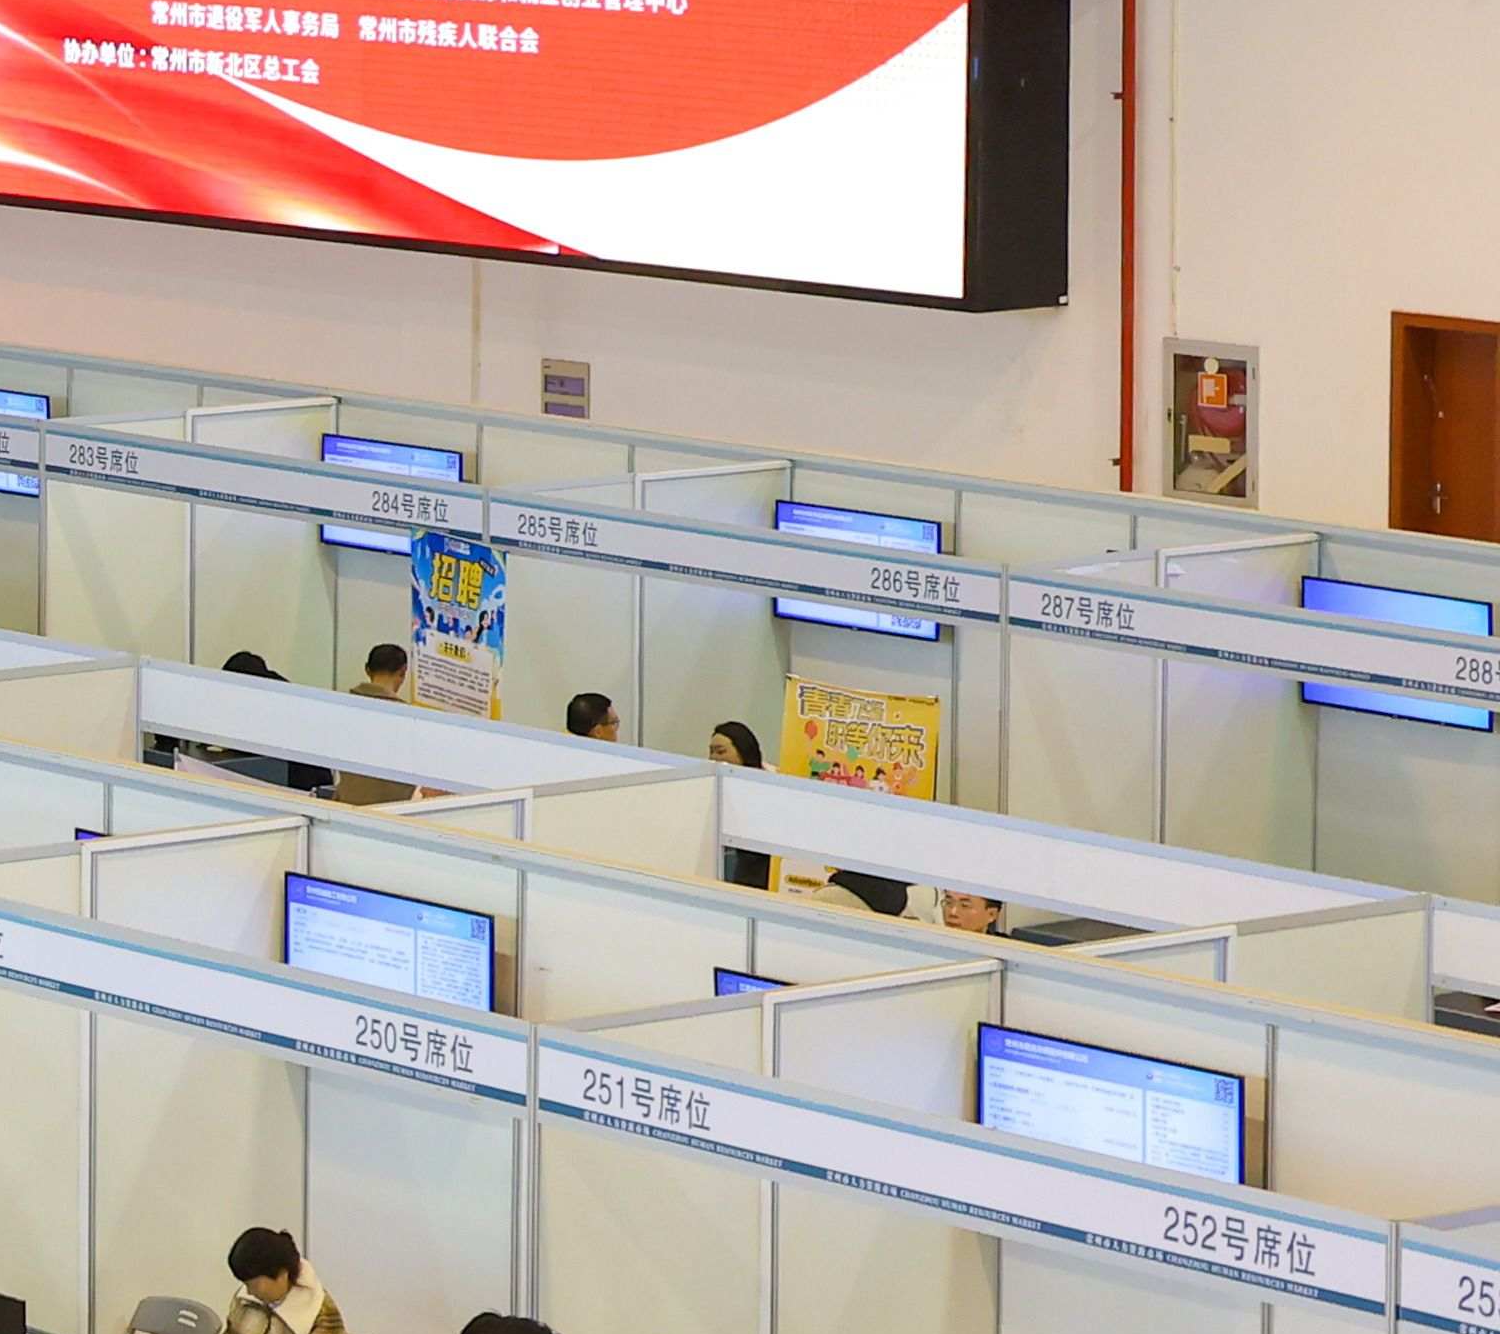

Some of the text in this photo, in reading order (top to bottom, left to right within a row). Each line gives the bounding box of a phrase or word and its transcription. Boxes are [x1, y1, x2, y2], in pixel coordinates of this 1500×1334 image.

[358, 15, 539, 54] 常州市残疾人联合会
[70, 443, 139, 476] 283号席位
[372, 491, 449, 523] 284号席位
[518, 514, 598, 548] 285号席位
[431, 552, 484, 612] 招聘
[871, 567, 961, 604] 286号席位
[1041, 593, 1135, 632] 287号席位
[1455, 654, 1500, 687] 288
[355, 1014, 475, 1075] 250号席位
[584, 1068, 712, 1133] 251号席位
[1163, 1206, 1317, 1277] 252号席位
[1458, 1276, 1500, 1318] 25
